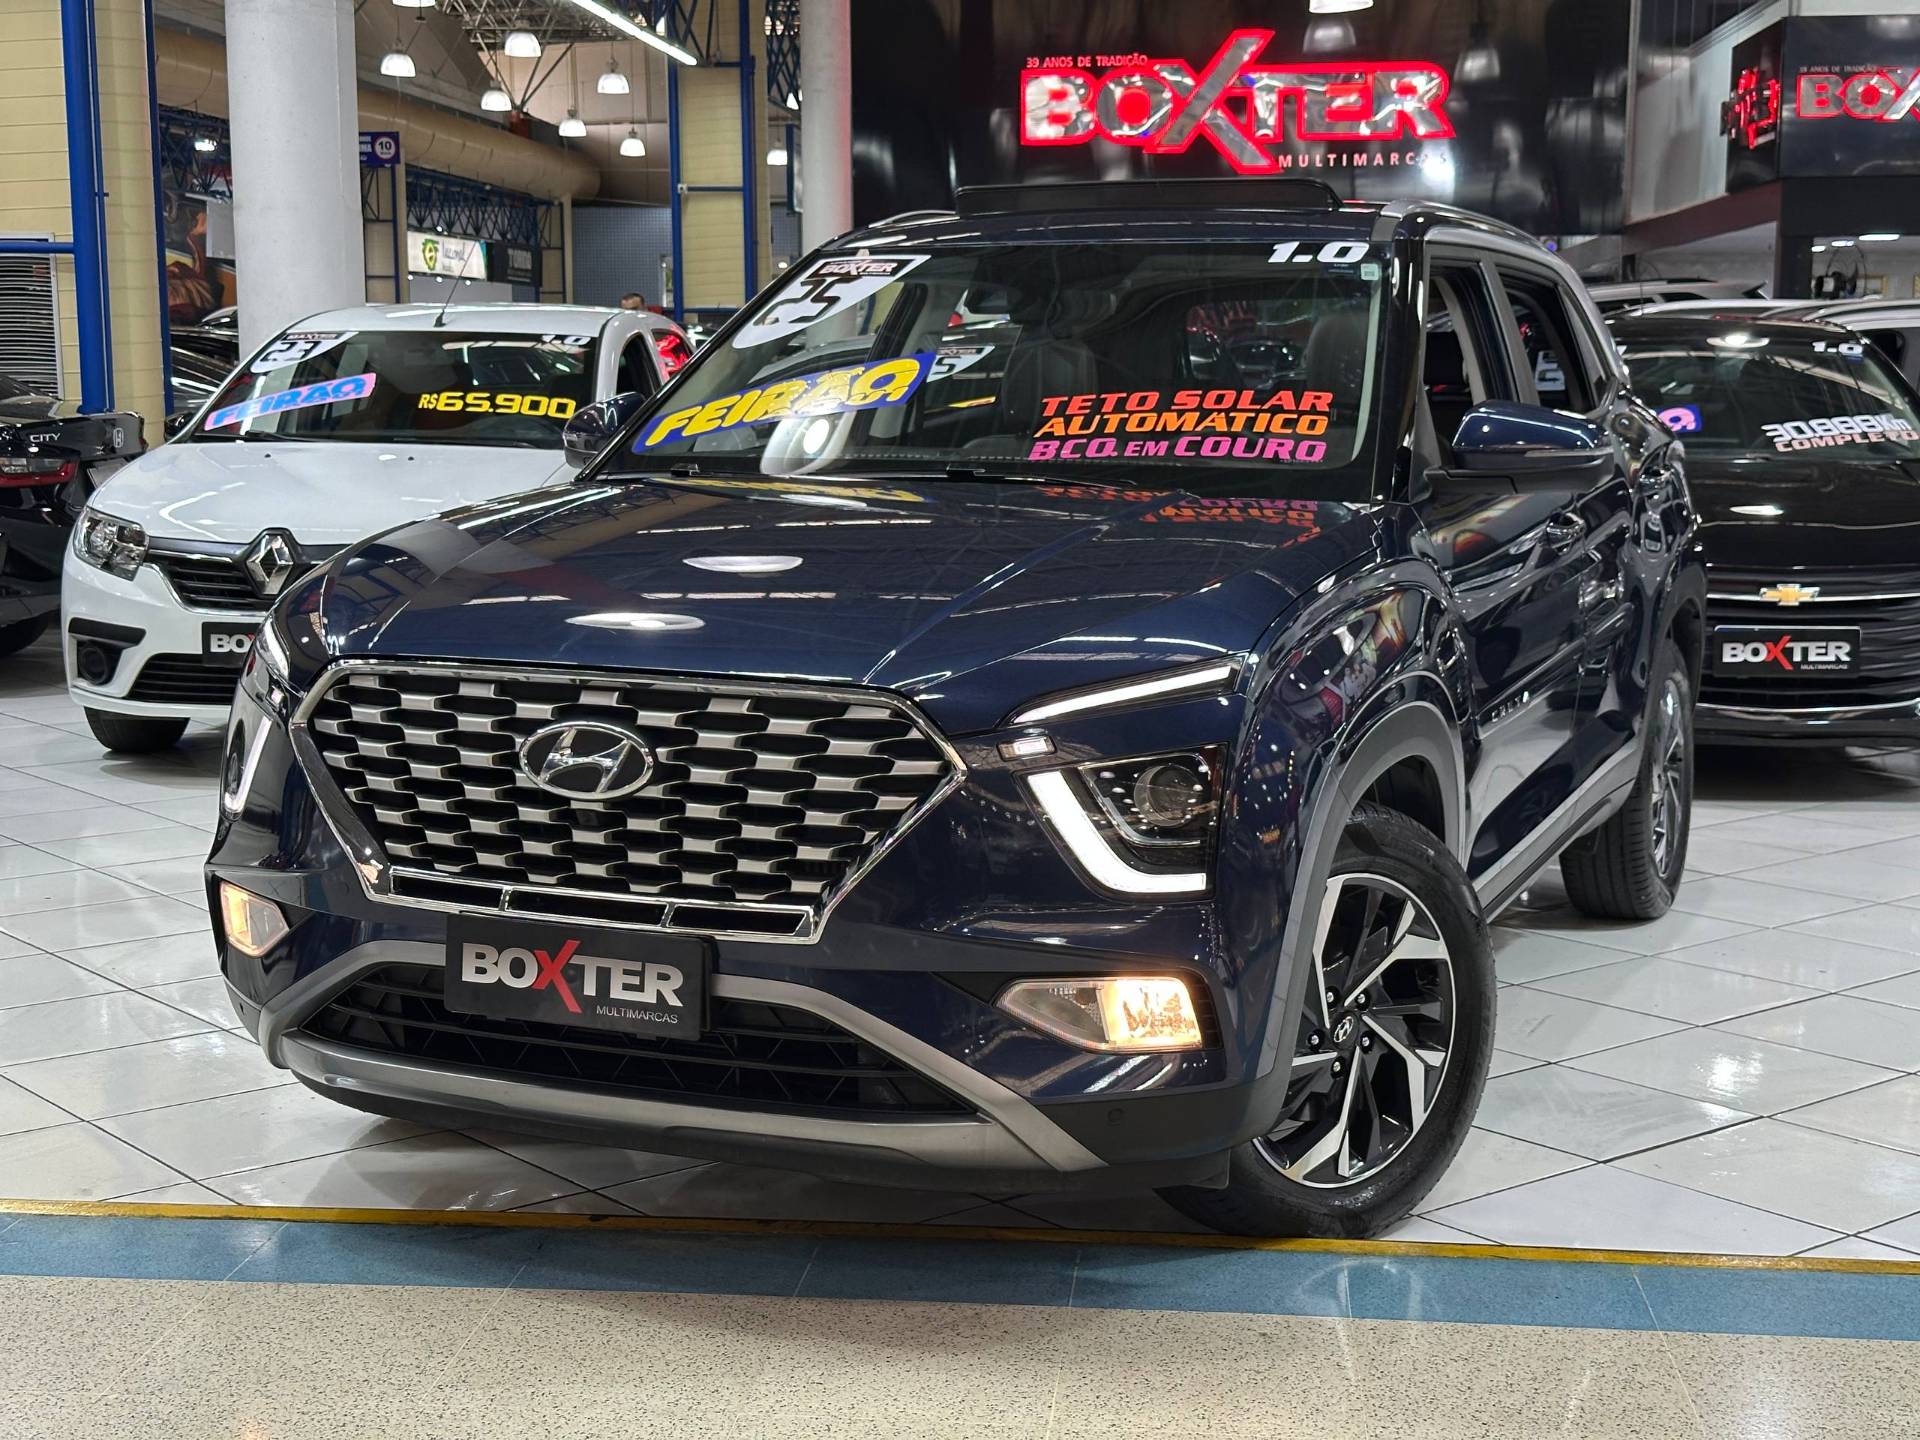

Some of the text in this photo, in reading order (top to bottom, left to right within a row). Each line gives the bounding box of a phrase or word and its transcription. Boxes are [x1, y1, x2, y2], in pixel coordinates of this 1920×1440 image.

[1026, 53, 1148, 69] 39 ANOS DE TRADIÇÃO
[1020, 28, 1456, 174] BOXTER
[379, 141, 392, 151] 10
[1278, 152, 1448, 168] MULTIMARCS
[1267, 241, 1370, 263] 1.0
[820, 259, 898, 276] BOXTER
[1812, 341, 1863, 355] 1.0
[1042, 389, 1333, 416] TETO SOLAR
[30, 432, 61, 443] CITY
[1775, 429, 1920, 452] COMPLETO
[1124, 440, 1169, 457] EM
[1174, 436, 1327, 461] COURO
[210, 633, 257, 653] BO
[1722, 635, 1850, 671] BOXTER
[461, 939, 684, 1014] BOXTER
[596, 1004, 678, 1025] MULTIMARCAS
